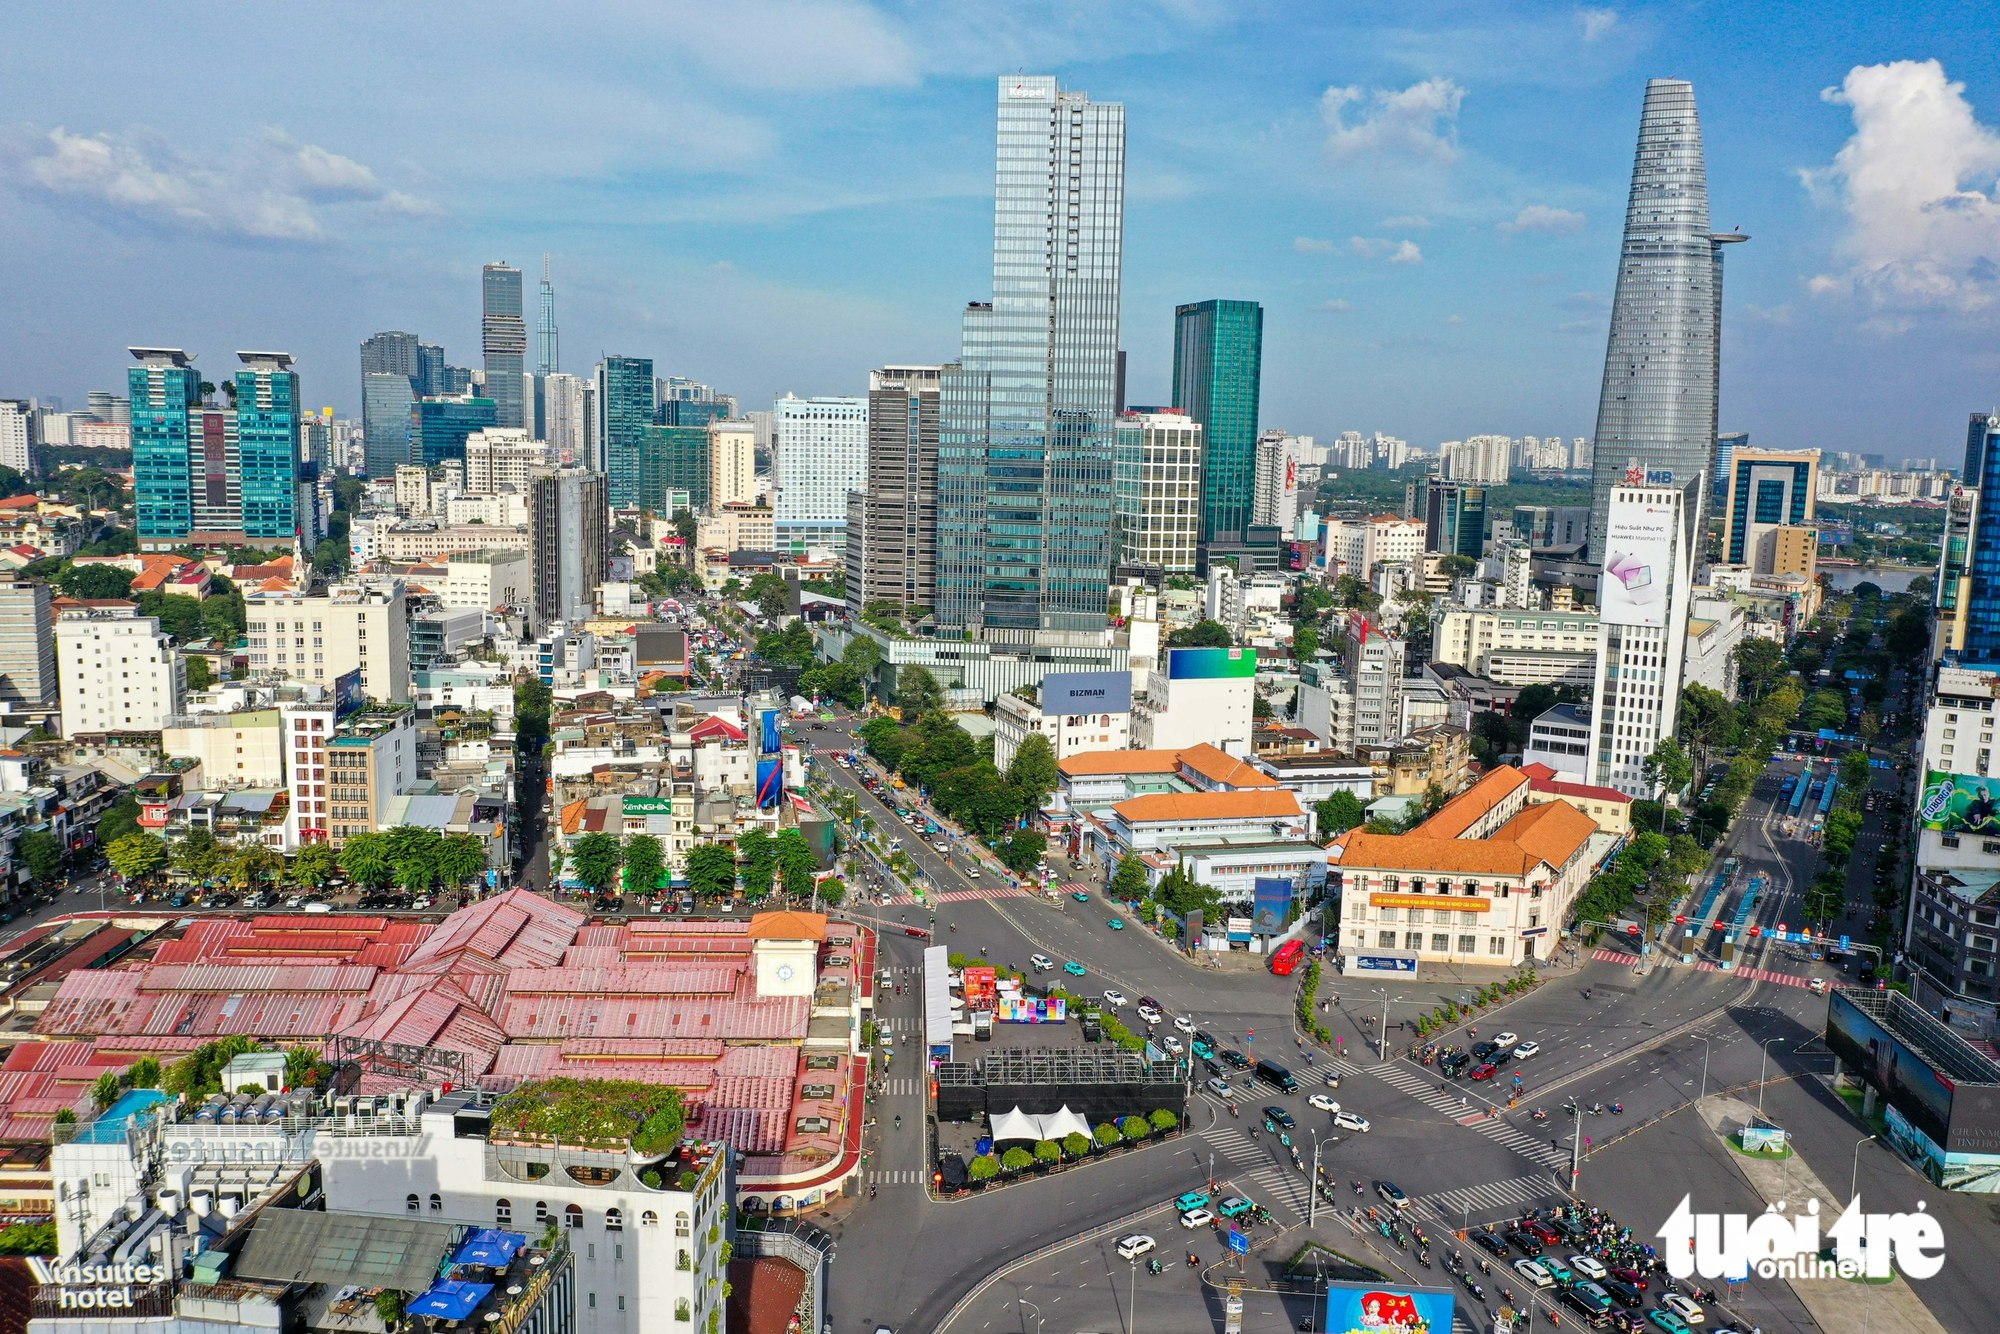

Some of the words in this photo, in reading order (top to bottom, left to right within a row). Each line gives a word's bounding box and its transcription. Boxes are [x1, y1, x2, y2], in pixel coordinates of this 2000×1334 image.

[1009, 87, 1045, 98] Keppel
[881, 380, 904, 388] Keppel
[1646, 470, 1673, 484] MB
[1069, 689, 1105, 697] BIZMAN
[25, 1255, 166, 1285] Vinsuites
[60, 1284, 135, 1309] hotel
